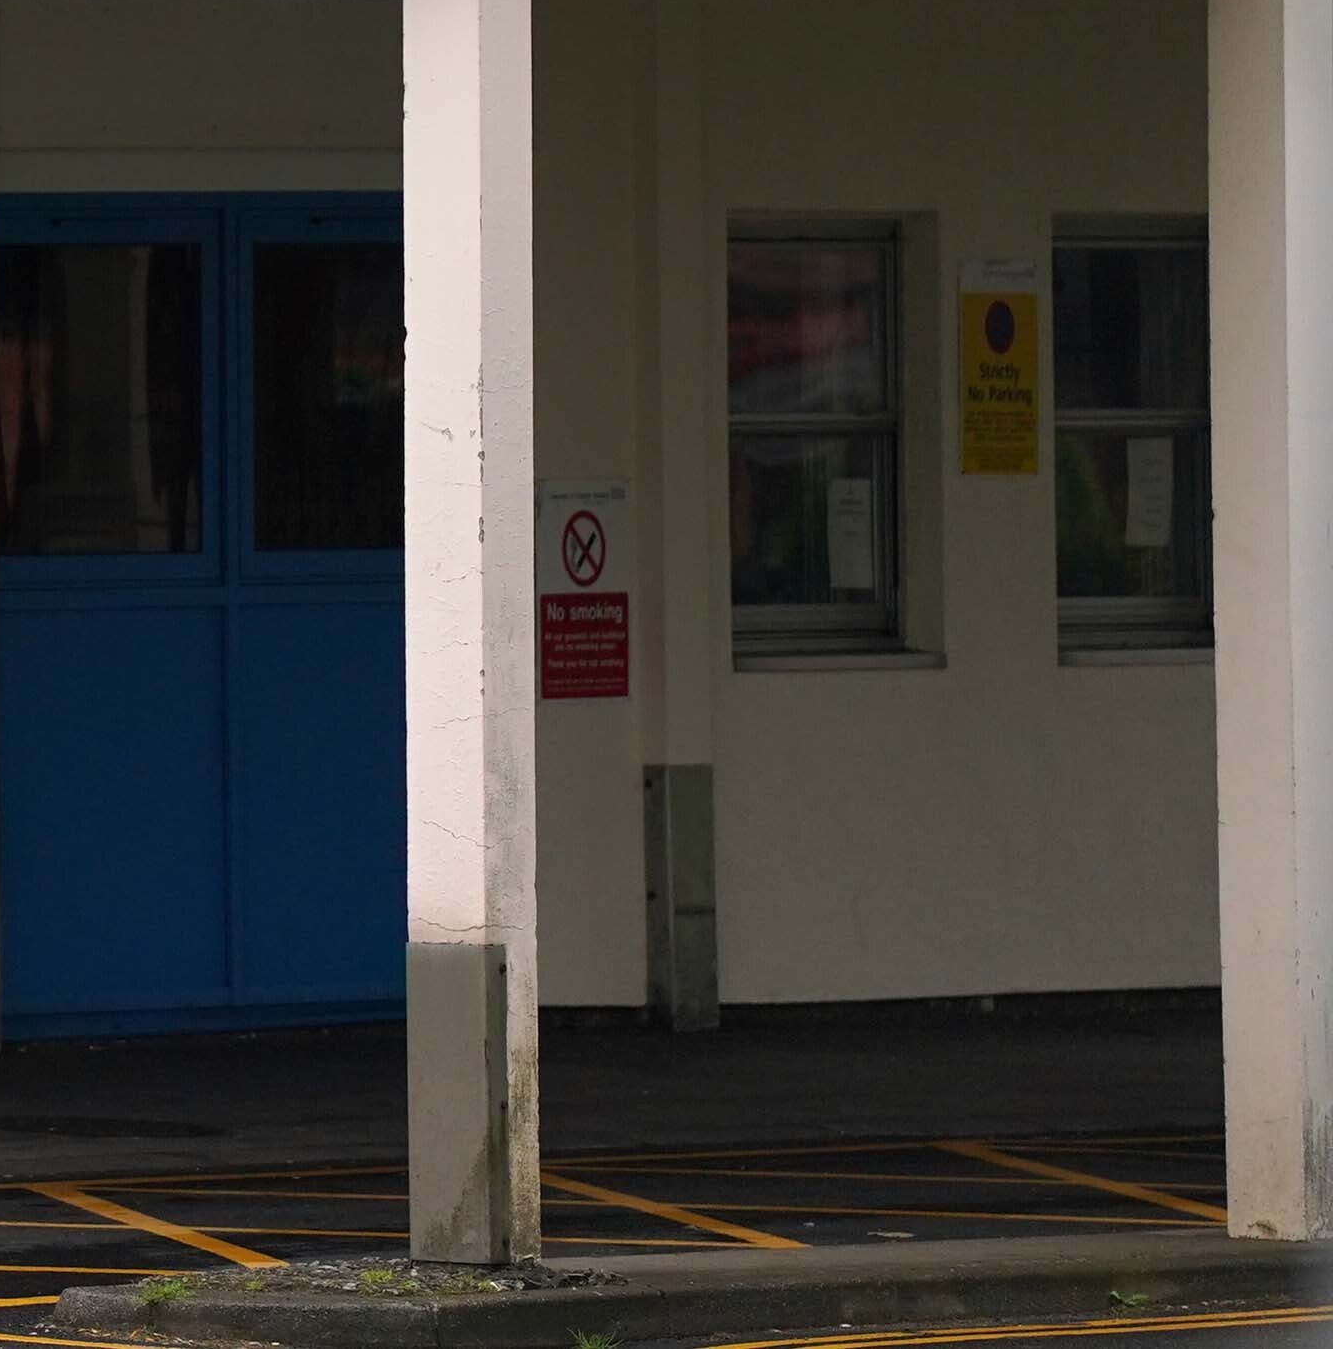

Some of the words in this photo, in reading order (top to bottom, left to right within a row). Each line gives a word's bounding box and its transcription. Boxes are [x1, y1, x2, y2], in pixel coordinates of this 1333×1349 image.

[979, 363, 1021, 385] Strictly
[968, 386, 983, 402] No
[989, 386, 1032, 406] Parking
[547, 602, 565, 620] No
[570, 601, 623, 624] smoking
